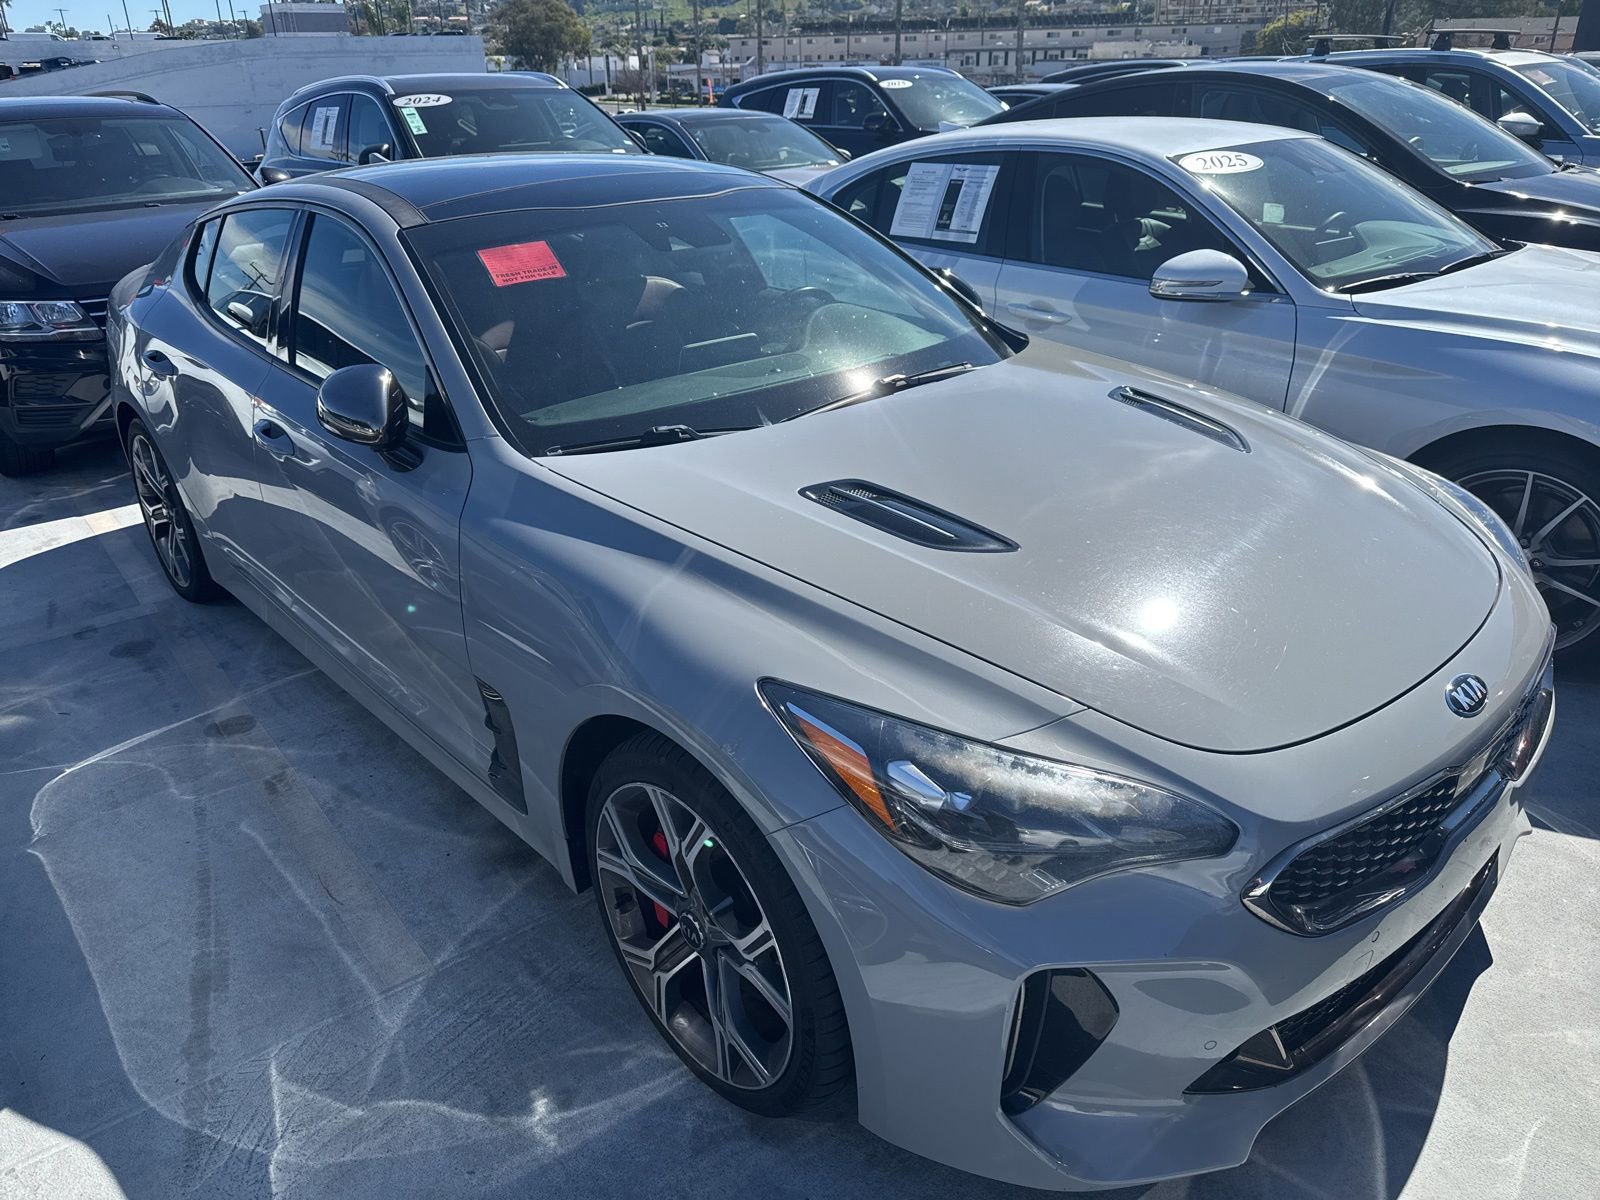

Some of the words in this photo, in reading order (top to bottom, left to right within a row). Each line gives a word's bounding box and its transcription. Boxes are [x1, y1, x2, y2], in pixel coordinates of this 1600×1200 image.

[403, 96, 441, 106] 2024
[1196, 154, 1248, 170] 2025
[522, 264, 558, 275] TRADE-IN
[1451, 677, 1487, 711] KIA
[681, 921, 699, 945] KIA
